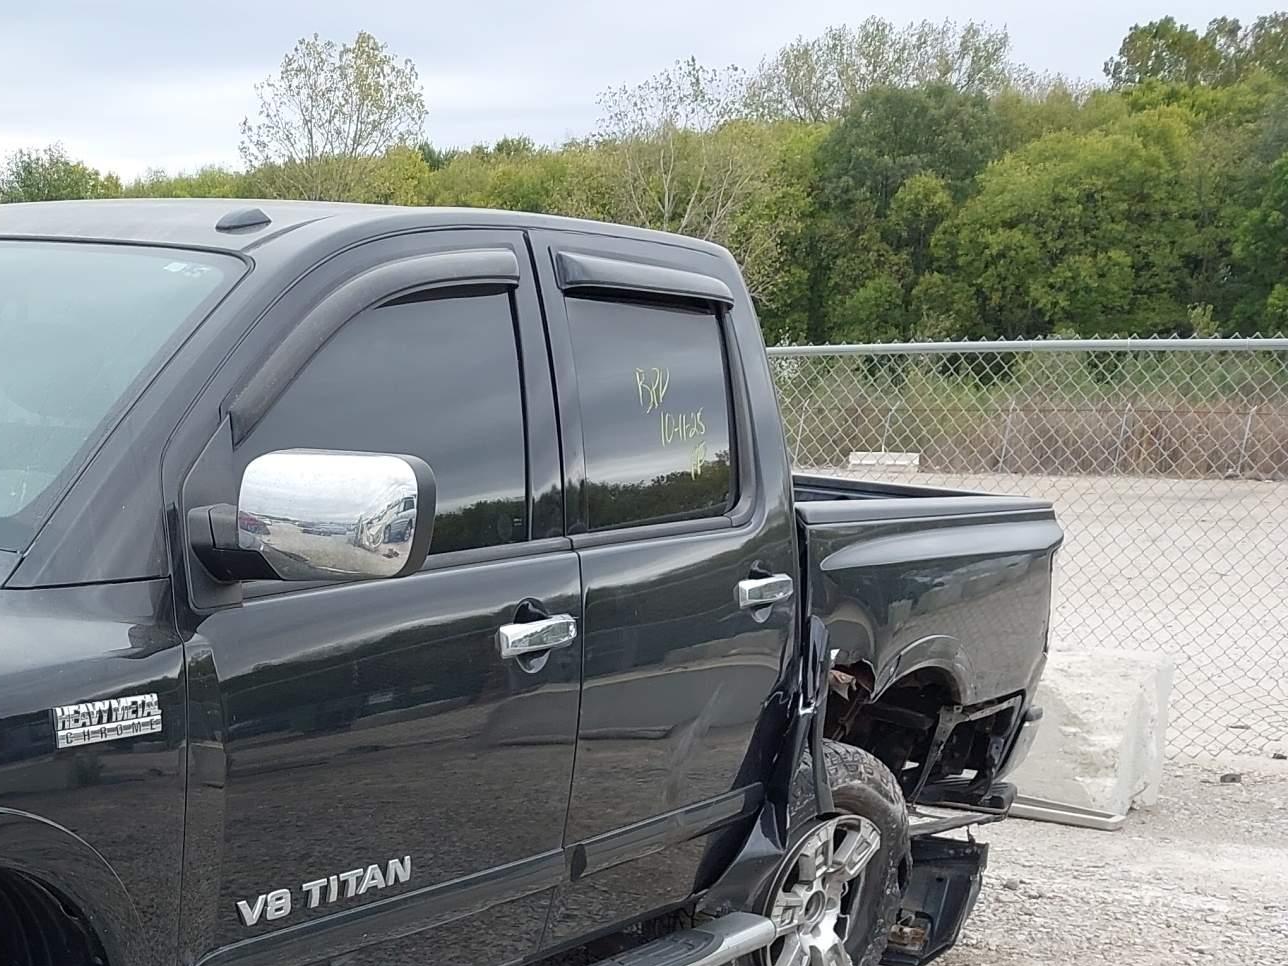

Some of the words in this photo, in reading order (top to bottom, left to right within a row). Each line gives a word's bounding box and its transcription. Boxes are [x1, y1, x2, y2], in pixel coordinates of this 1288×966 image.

[55, 701, 110, 731] HEAVY
[111, 693, 162, 722] METAL
[64, 718, 162, 745] CHROME
[236, 888, 292, 926] V8
[302, 855, 412, 909] TITAN
